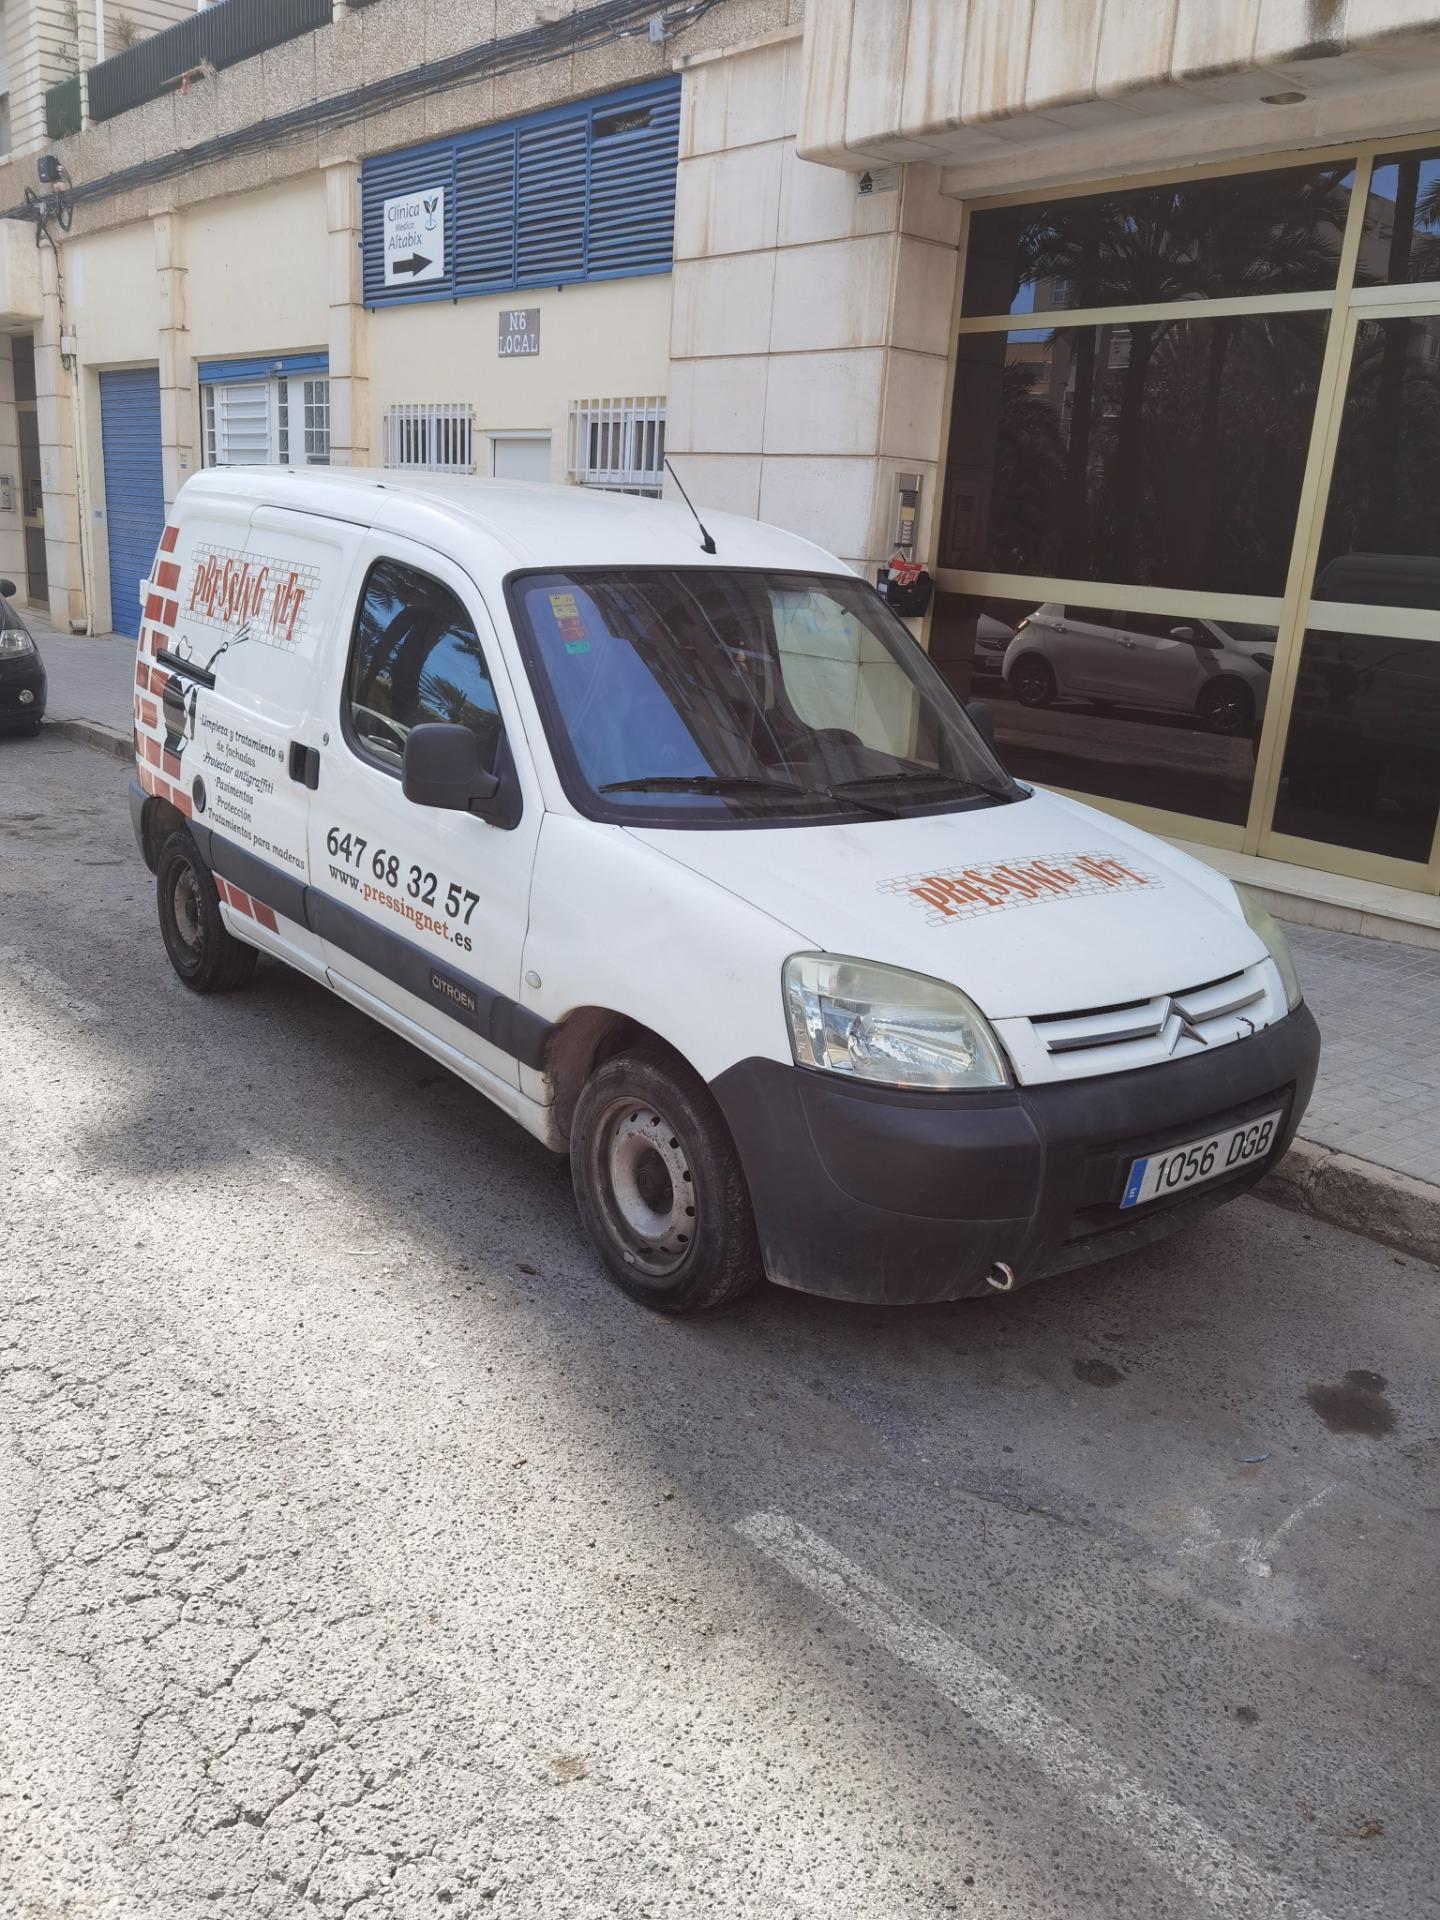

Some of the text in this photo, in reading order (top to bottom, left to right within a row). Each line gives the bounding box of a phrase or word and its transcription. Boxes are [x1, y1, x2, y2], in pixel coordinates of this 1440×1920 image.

[388, 203, 420, 221] Clínica
[388, 231, 423, 250] Altabix
[499, 334, 538, 354] LOCAL
[190, 554, 305, 641] PRESSING NET
[225, 743, 256, 768] fachadas
[235, 729, 276, 758] tratamiento
[234, 768, 275, 795] antigraffiti
[252, 834, 271, 851] para
[272, 845, 305, 870] maderas
[326, 827, 480, 925] 647 68 32 57
[908, 859, 1080, 916] PRESSING
[328, 864, 473, 952] www.pressingnet.es
[1154, 1141, 1219, 1193] 1056
[1225, 1120, 1274, 1167] DGB
